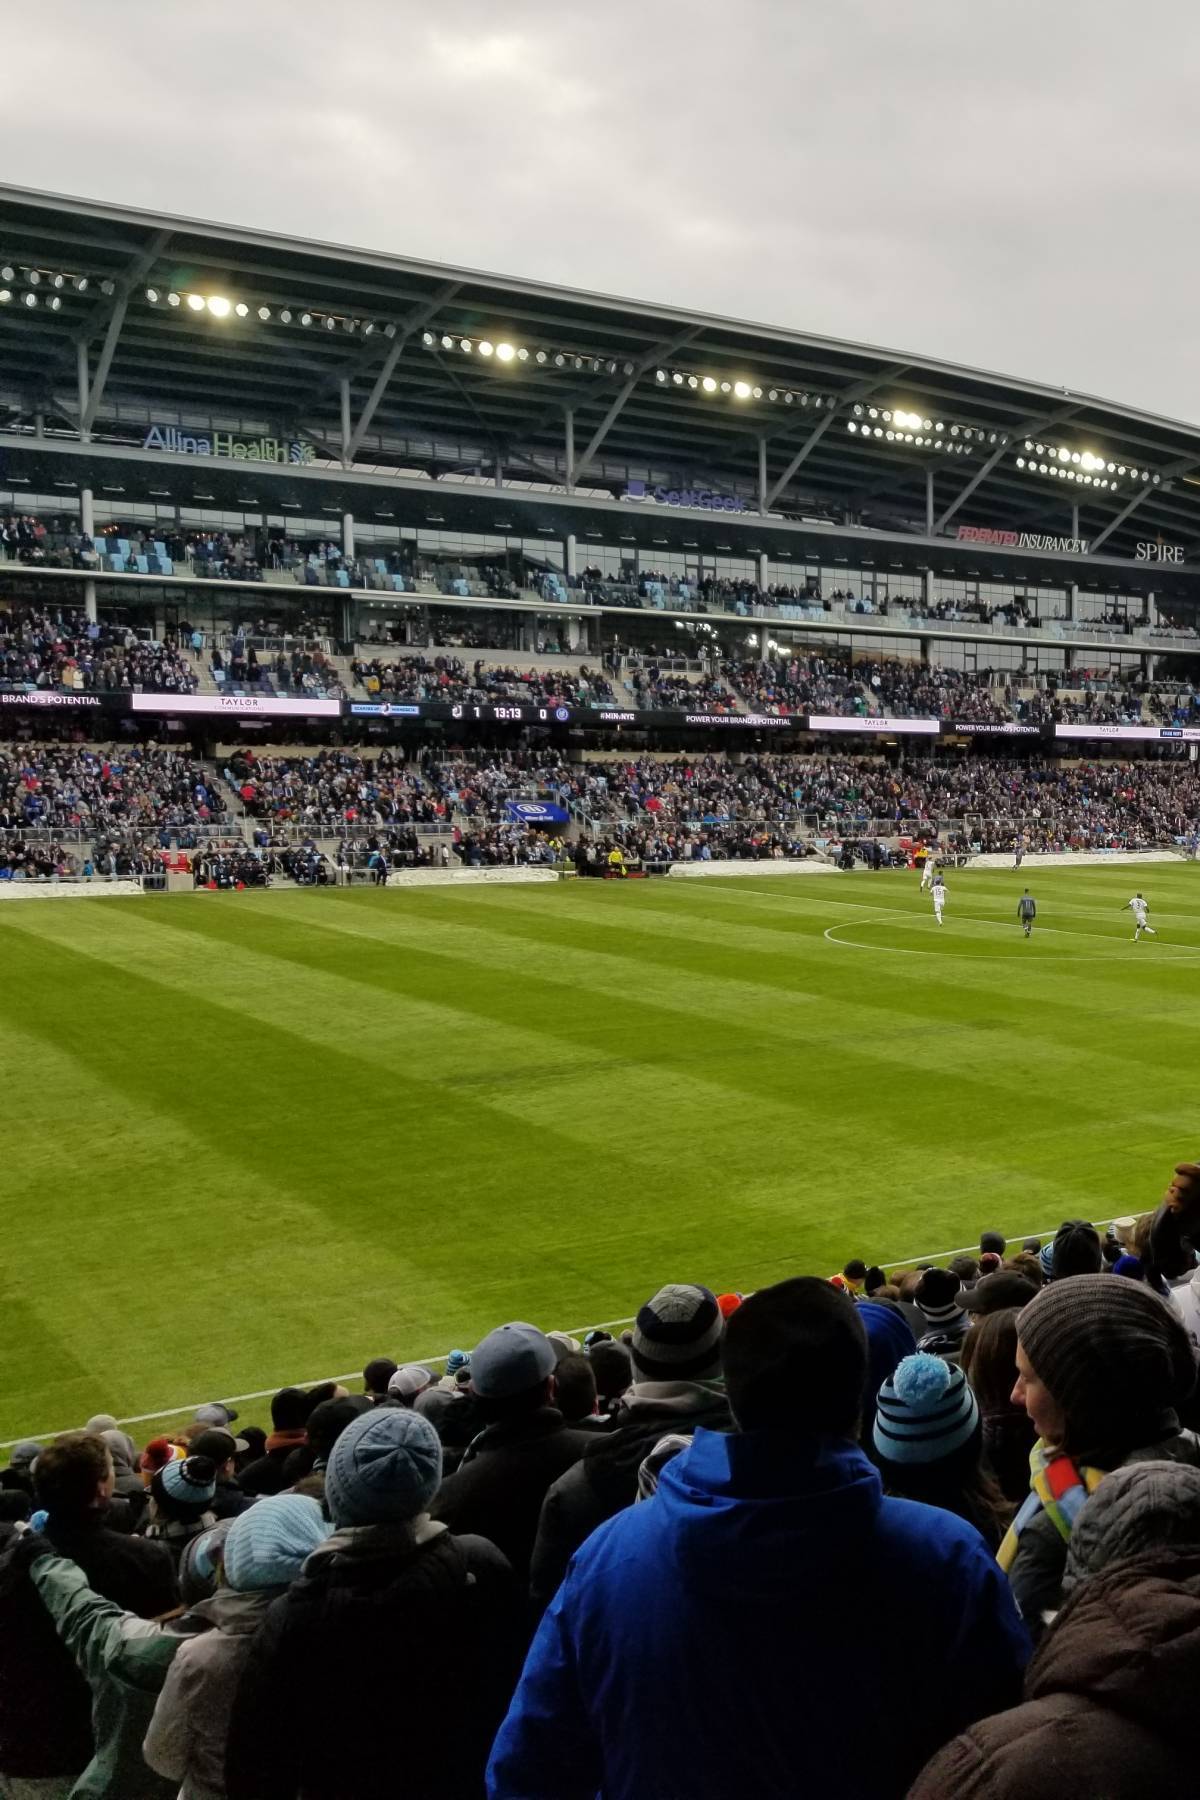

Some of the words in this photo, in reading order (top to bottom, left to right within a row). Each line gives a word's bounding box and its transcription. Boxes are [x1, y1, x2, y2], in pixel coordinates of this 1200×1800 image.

[655, 485, 744, 511] SeatGeek
[957, 526, 1018, 546] FEDERATED
[1018, 533, 1080, 553] INSURANCE
[1136, 542, 1184, 563] SPIRE
[2, 695, 45, 704] BRAND'S
[47, 696, 101, 705] POTENTIAL
[221, 698, 258, 706] TAYLOR
[474, 707, 479, 717] 1
[494, 708, 521, 719] 13:13
[540, 709, 546, 719] 0
[730, 717, 757, 725] BRAND'S
[758, 717, 791, 725] POTENTIAL
